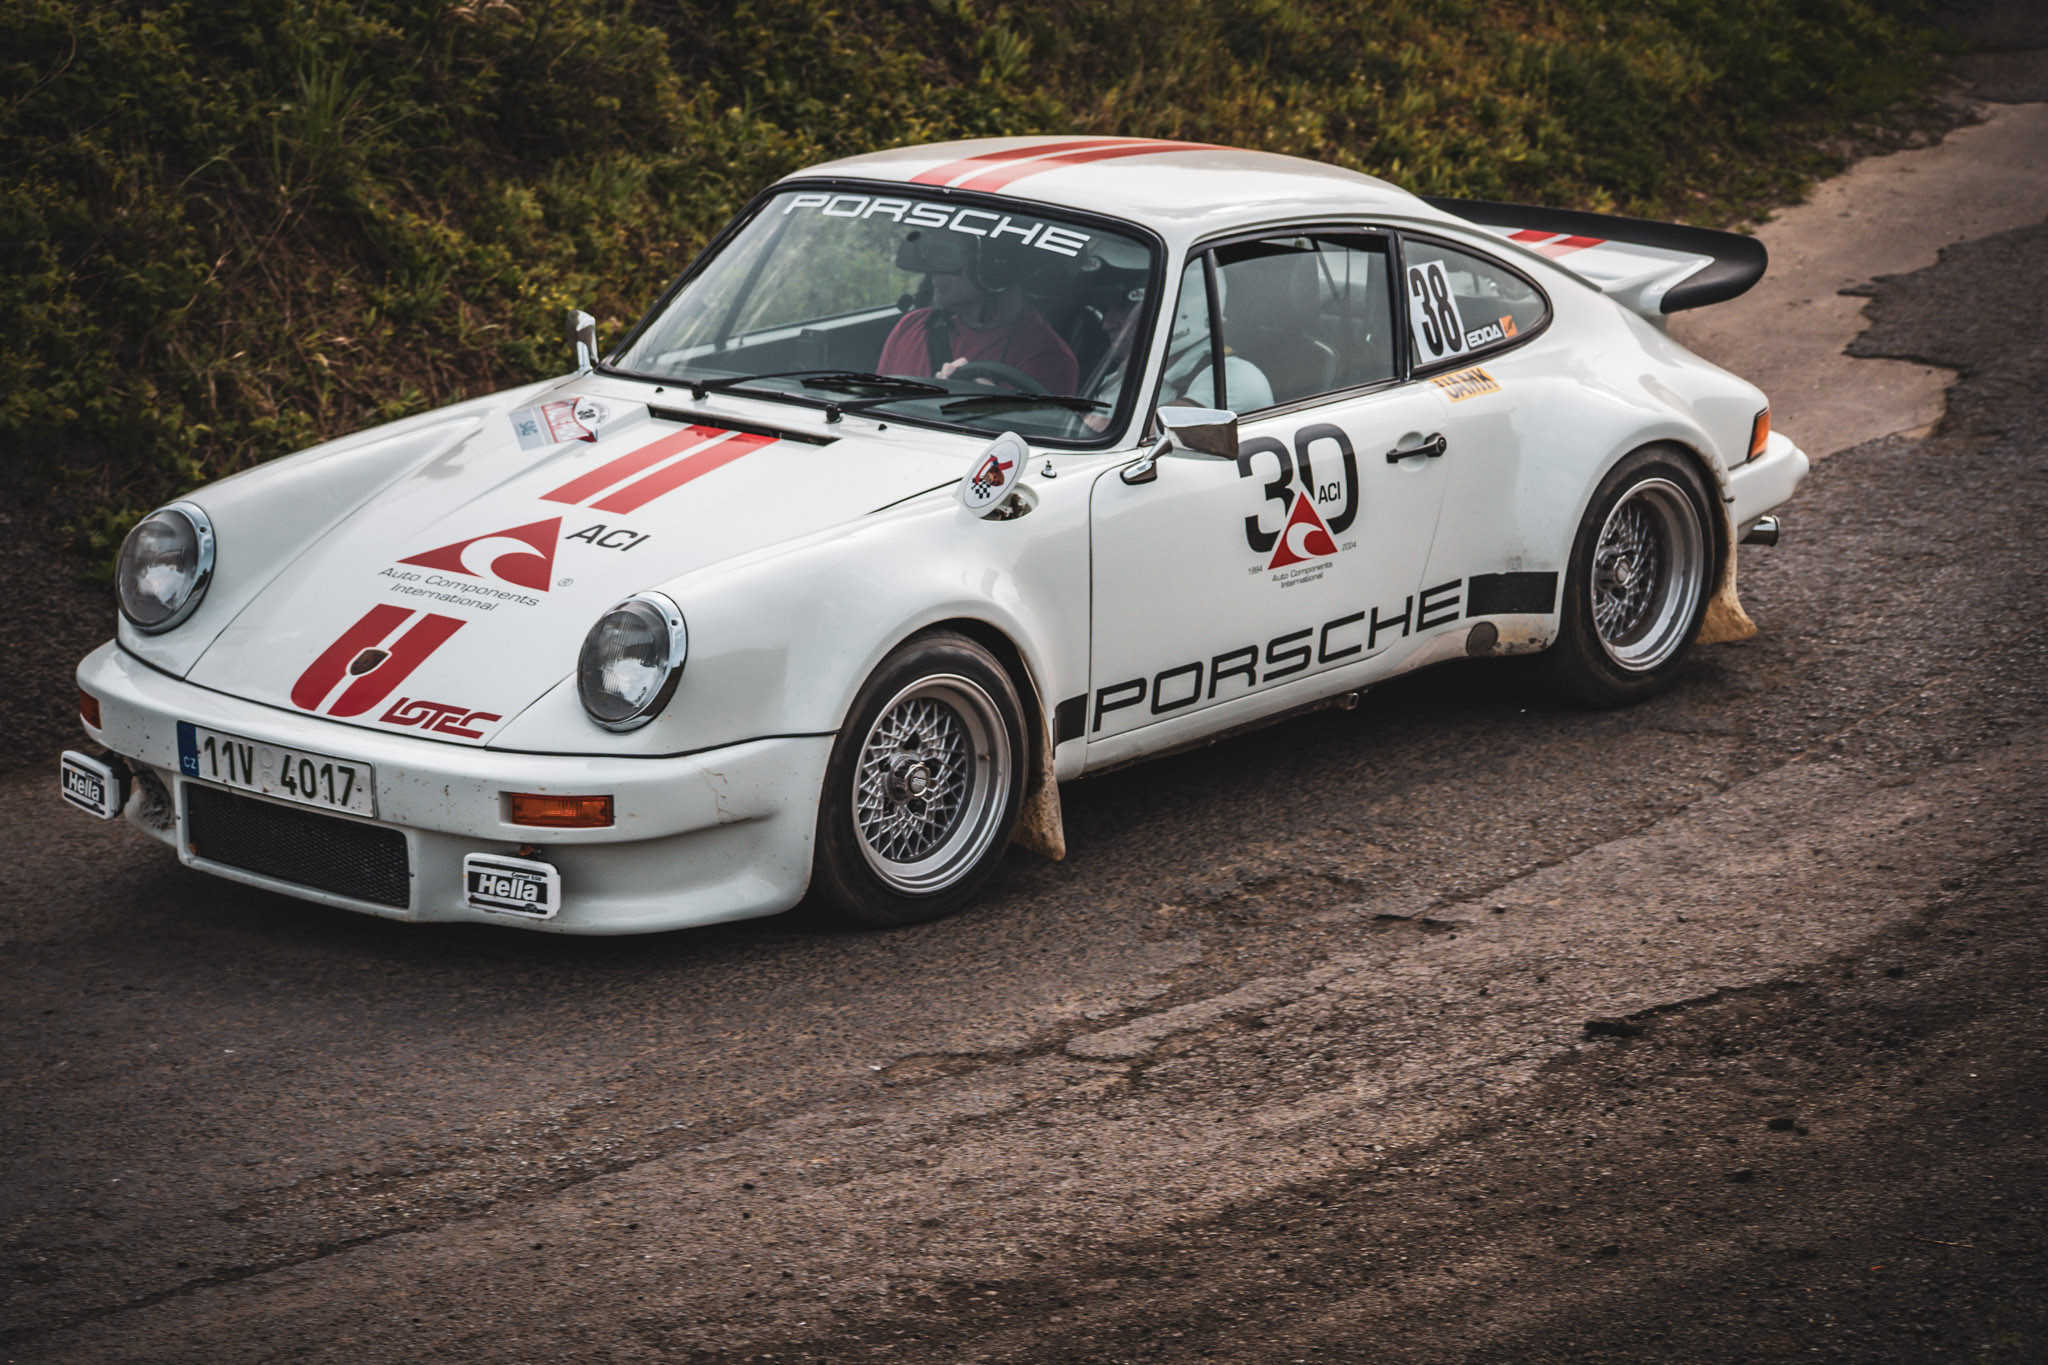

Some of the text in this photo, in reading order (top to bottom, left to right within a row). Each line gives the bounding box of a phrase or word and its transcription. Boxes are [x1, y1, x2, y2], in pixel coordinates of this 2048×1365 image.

[783, 194, 1091, 257] PORSCHE
[1409, 264, 1462, 357] 38
[1466, 323, 1502, 347] EDDA
[577, 408, 596, 420] 38
[1237, 423, 1359, 553] 30
[1318, 481, 1341, 505] ACI
[564, 524, 651, 552] ACI
[1342, 541, 1357, 552] 2024
[1248, 565, 1263, 575] 1994
[1272, 561, 1333, 582] Auto Components
[1281, 571, 1324, 588] International
[377, 567, 540, 607] Auto Components
[390, 582, 500, 611] International
[1092, 578, 1462, 733] PORSCHE
[378, 698, 503, 739] LOTEC
[183, 756, 197, 769] CZ
[204, 735, 355, 806] 11V 4017
[68, 771, 100, 802] Hella
[478, 873, 538, 901] Hella
